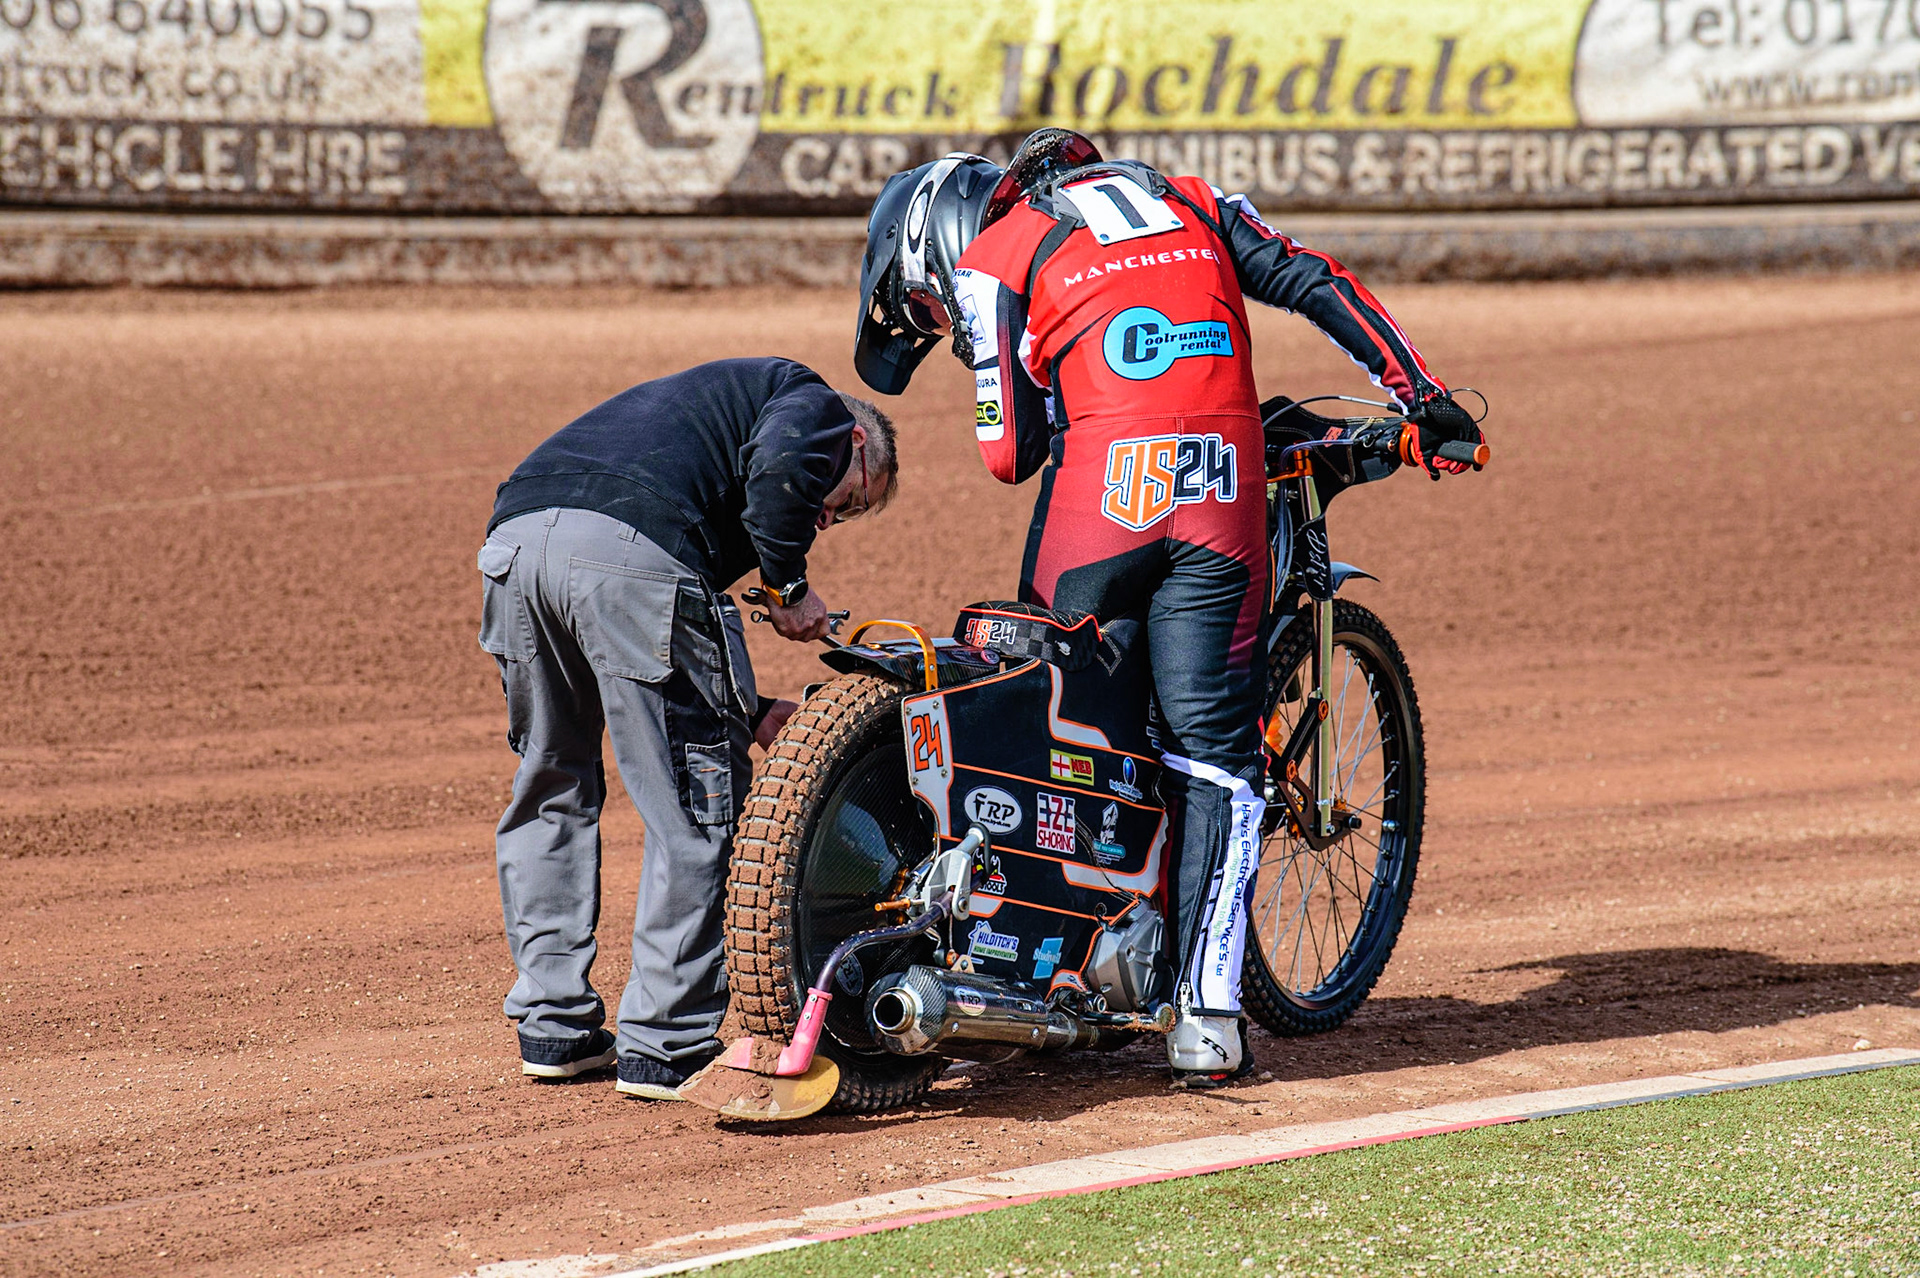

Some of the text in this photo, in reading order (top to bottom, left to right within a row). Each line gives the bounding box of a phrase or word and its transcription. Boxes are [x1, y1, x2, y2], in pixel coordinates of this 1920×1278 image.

[256, 128, 406, 195] HIRE
[1350, 132, 1394, 194] &
[1401, 126, 1852, 194] REFRIGERATED
[1093, 183, 1149, 230] 1
[1063, 248, 1220, 287] MANCHESTE
[1180, 340, 1221, 351] rental
[911, 712, 944, 772] 24
[1037, 829, 1075, 852] SHORING
[1240, 803, 1252, 838] Hay's
[1233, 840, 1252, 900] Electrical
[977, 931, 1018, 950] HILDITCH'S
